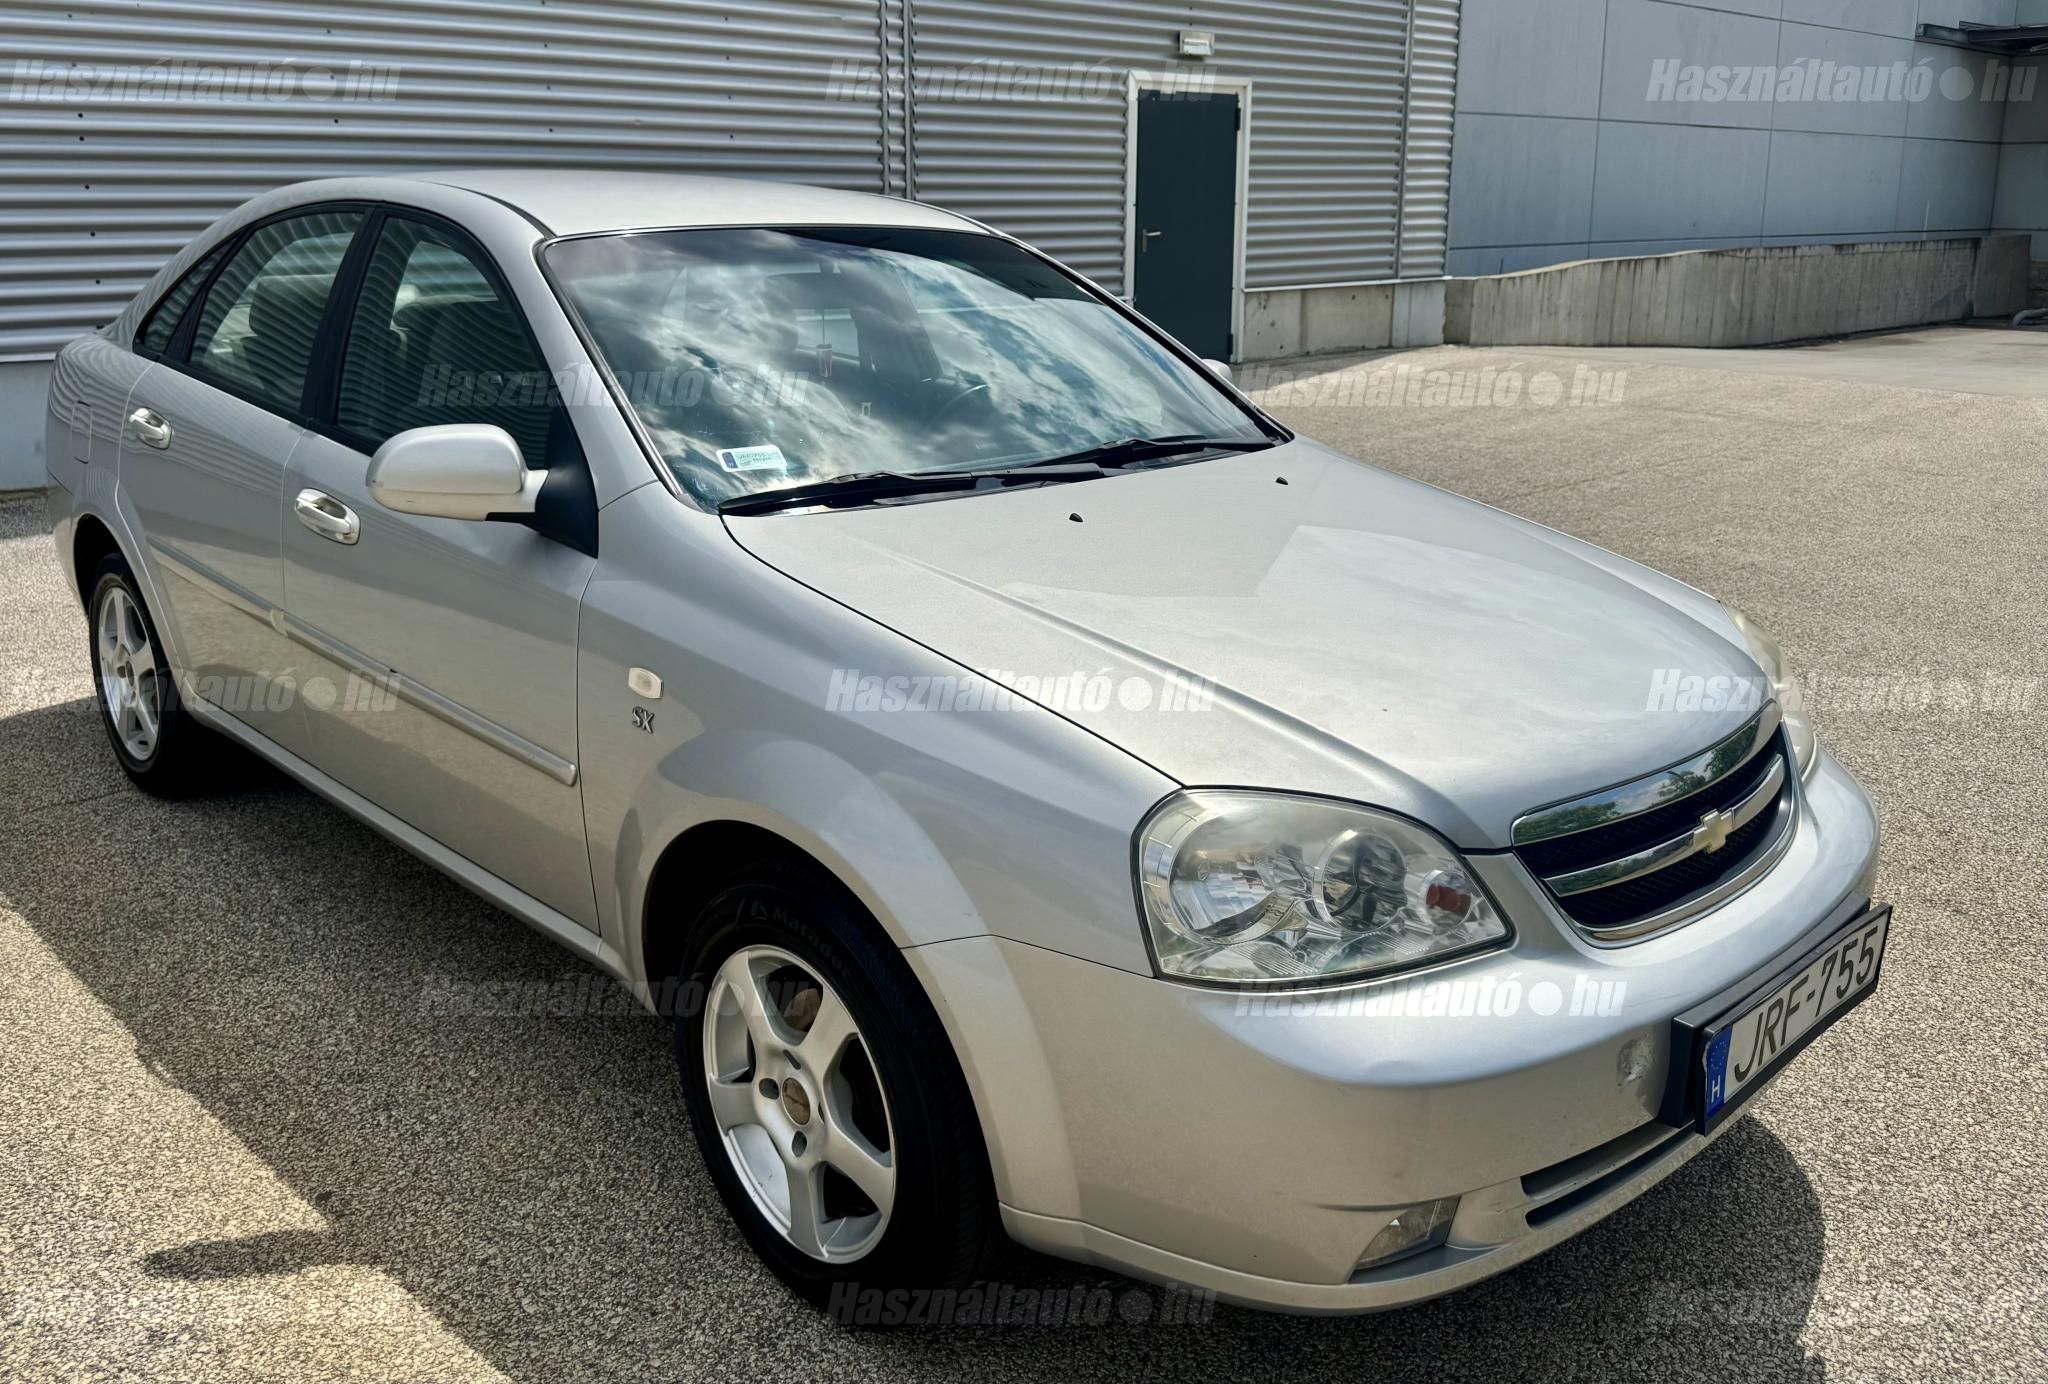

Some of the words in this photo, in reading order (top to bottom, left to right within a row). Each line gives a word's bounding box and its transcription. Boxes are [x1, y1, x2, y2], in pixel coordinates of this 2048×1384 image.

[632, 706, 655, 734] SX
[1734, 926, 1879, 1082] JRF-755
[1711, 1075, 1721, 1103] H
